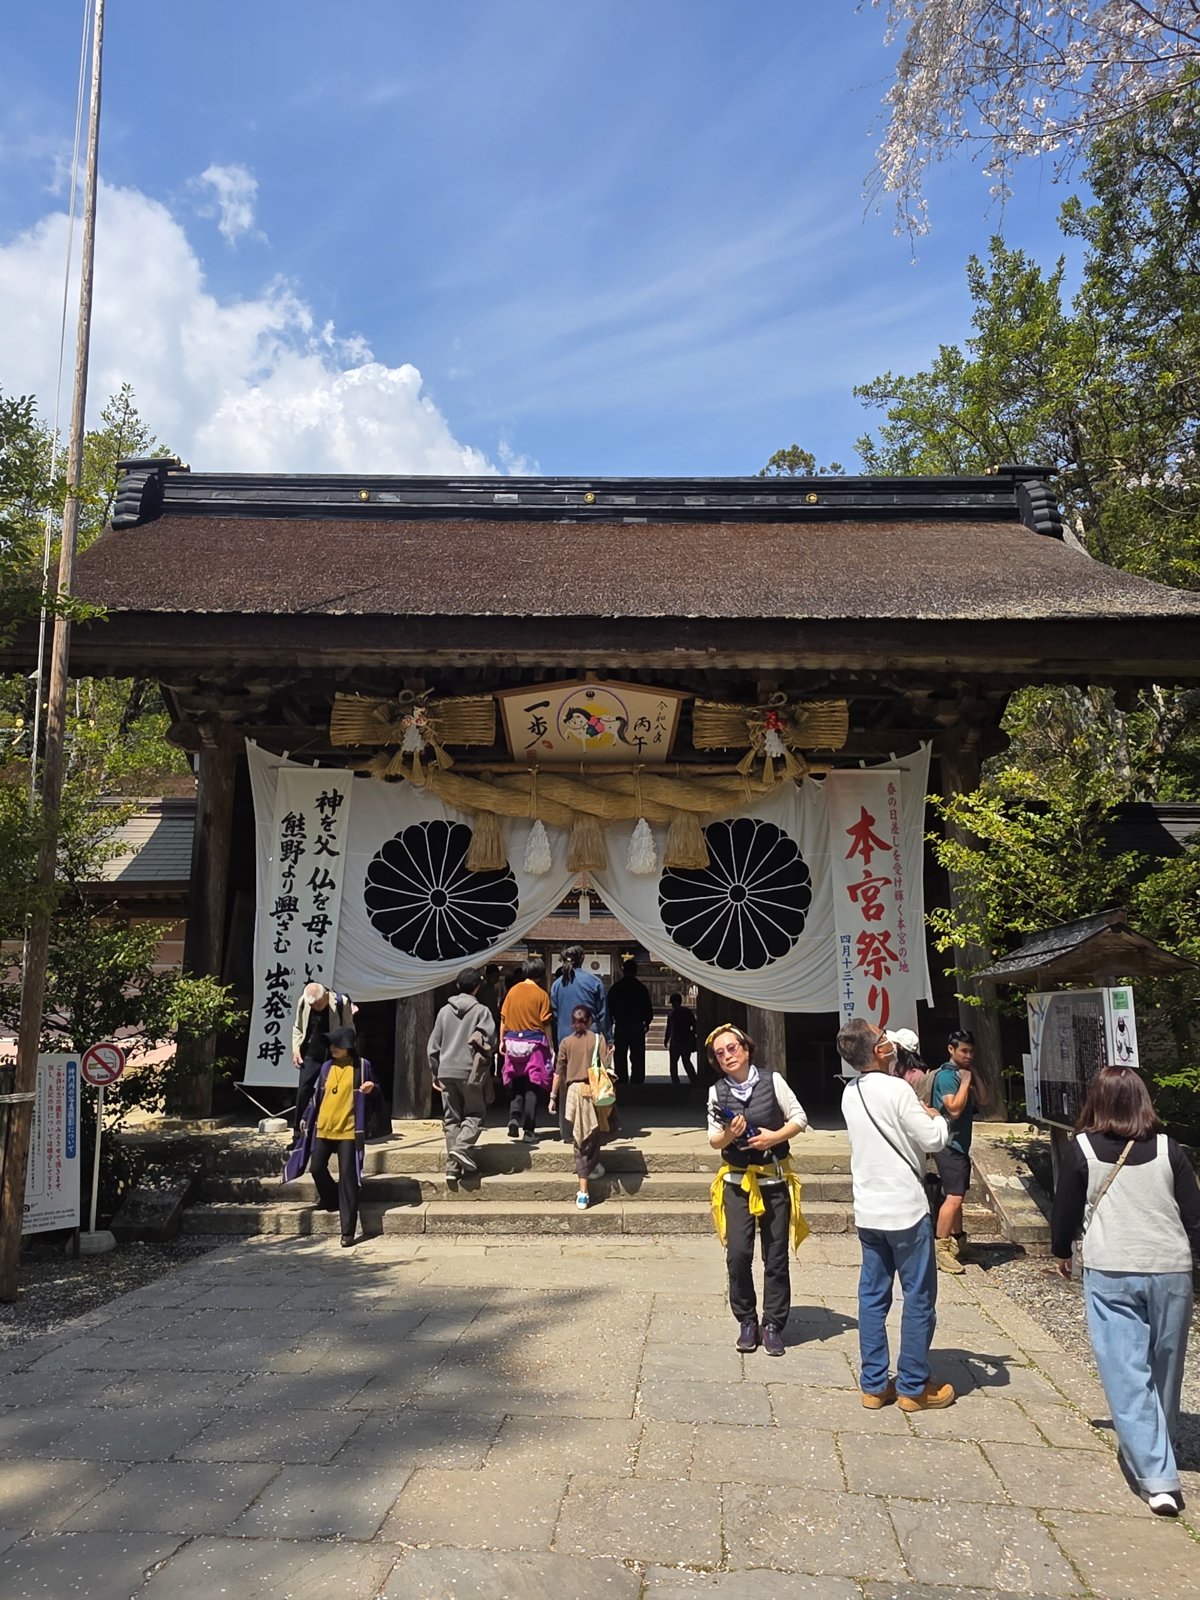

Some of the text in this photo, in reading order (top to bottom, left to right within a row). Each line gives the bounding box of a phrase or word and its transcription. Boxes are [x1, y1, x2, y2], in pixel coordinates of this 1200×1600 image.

[523, 700, 551, 750] 一歩
[633, 716, 651, 755] 丙午
[845, 805, 900, 1031] 本宮祭り
[840, 934, 856, 1021] 四月十三・十四・
